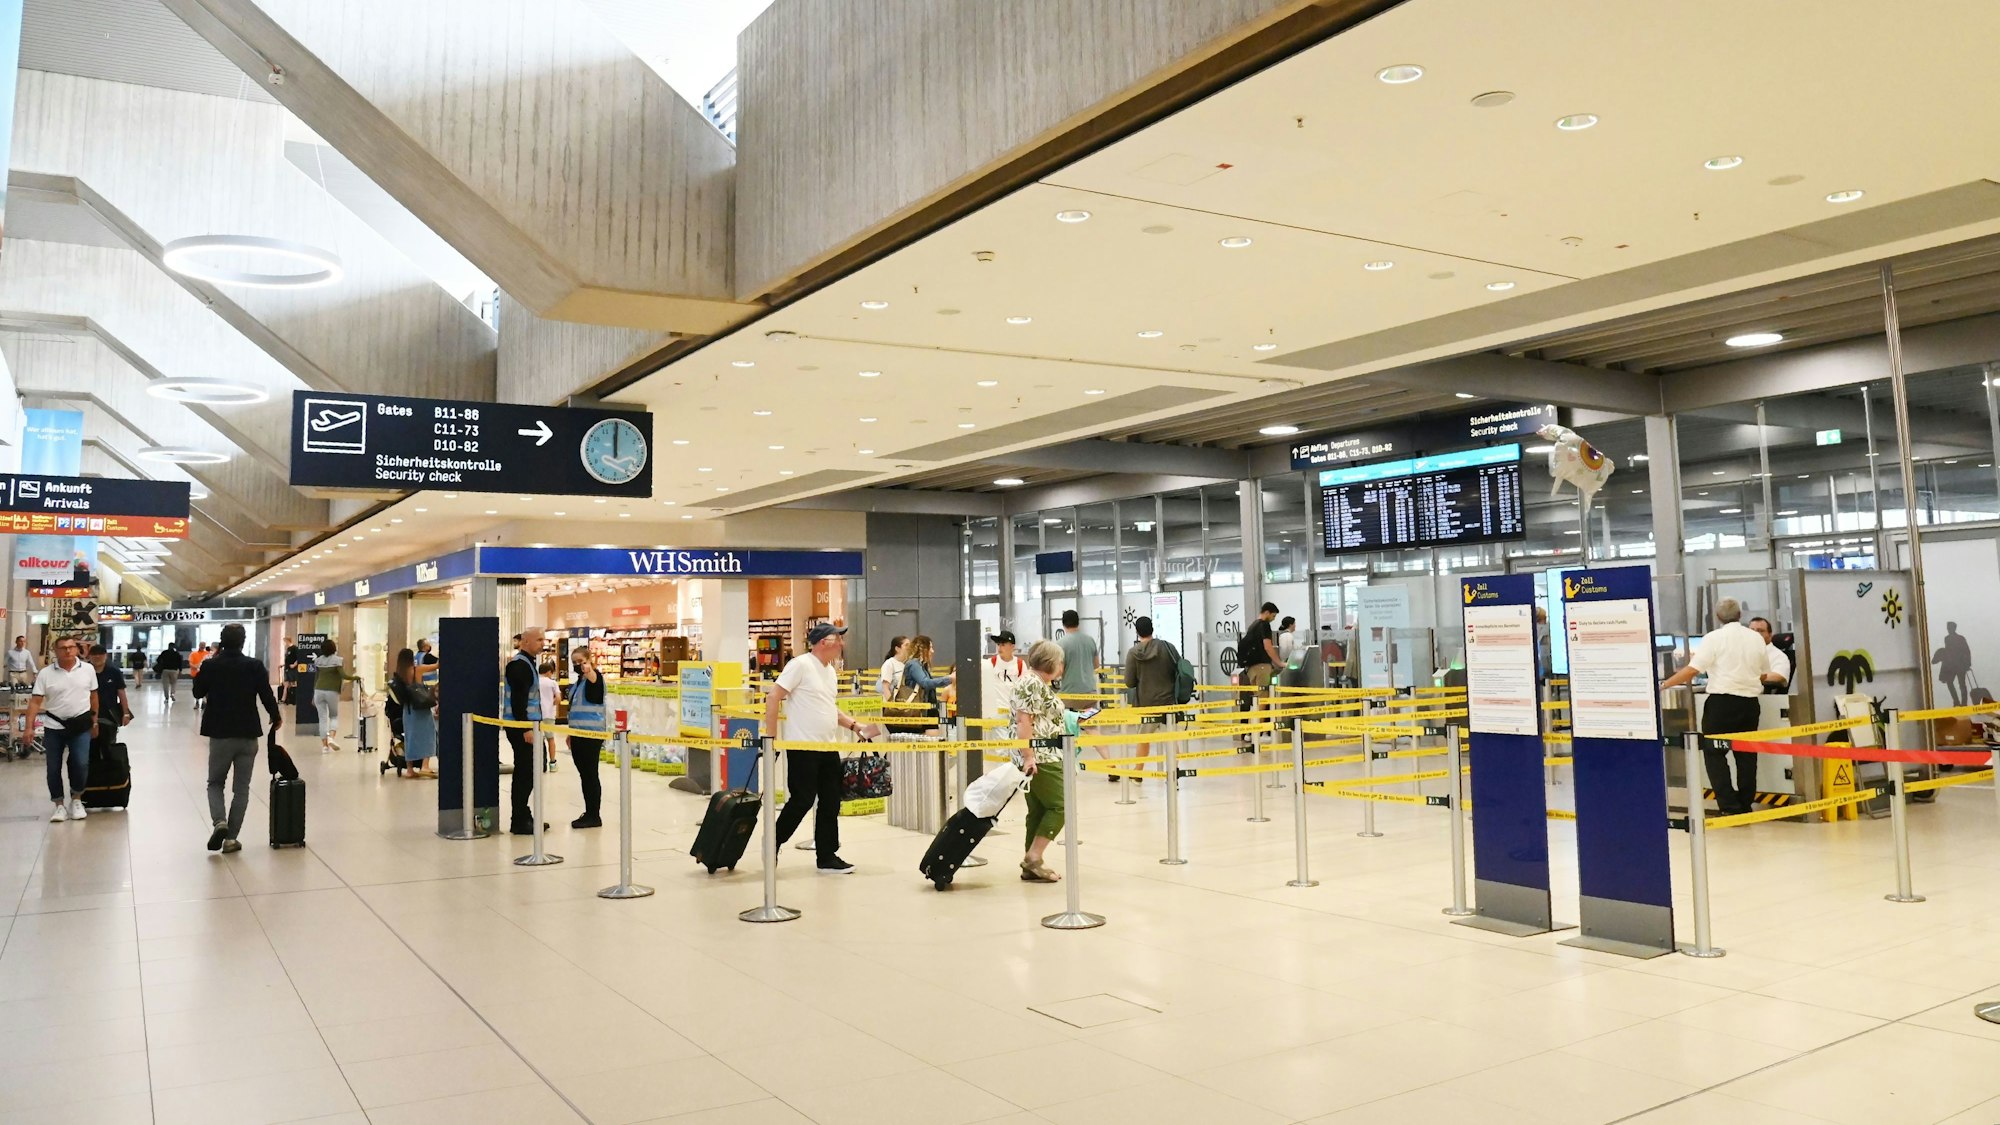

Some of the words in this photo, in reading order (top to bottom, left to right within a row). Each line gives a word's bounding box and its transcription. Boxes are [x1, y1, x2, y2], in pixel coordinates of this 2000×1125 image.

[377, 403, 413, 417] Gates
[434, 406, 480, 421] B11-86
[1470, 406, 1542, 426] Sicherheitskontrolle
[434, 422, 480, 437] C11-73
[1470, 424, 1498, 437] Security
[1499, 421, 1519, 433] check
[433, 439, 480, 453] D10-82
[1330, 438, 1360, 450] Departures
[375, 454, 502, 472] Sicherheitskontrolle
[375, 467, 425, 483] Security
[429, 470, 462, 483] check
[45, 481, 93, 495] Ankunft
[44, 497, 90, 510] Arrivals
[19, 556, 71, 569] alltours
[628, 551, 743, 574] WHSmith
[1477, 583, 1488, 591] Zoll
[1581, 576, 1594, 585] Zoll
[1477, 591, 1499, 600] Customs
[1581, 585, 1608, 594] Customs
[775, 594, 792, 608] KASS
[298, 635, 325, 643] Eingang
